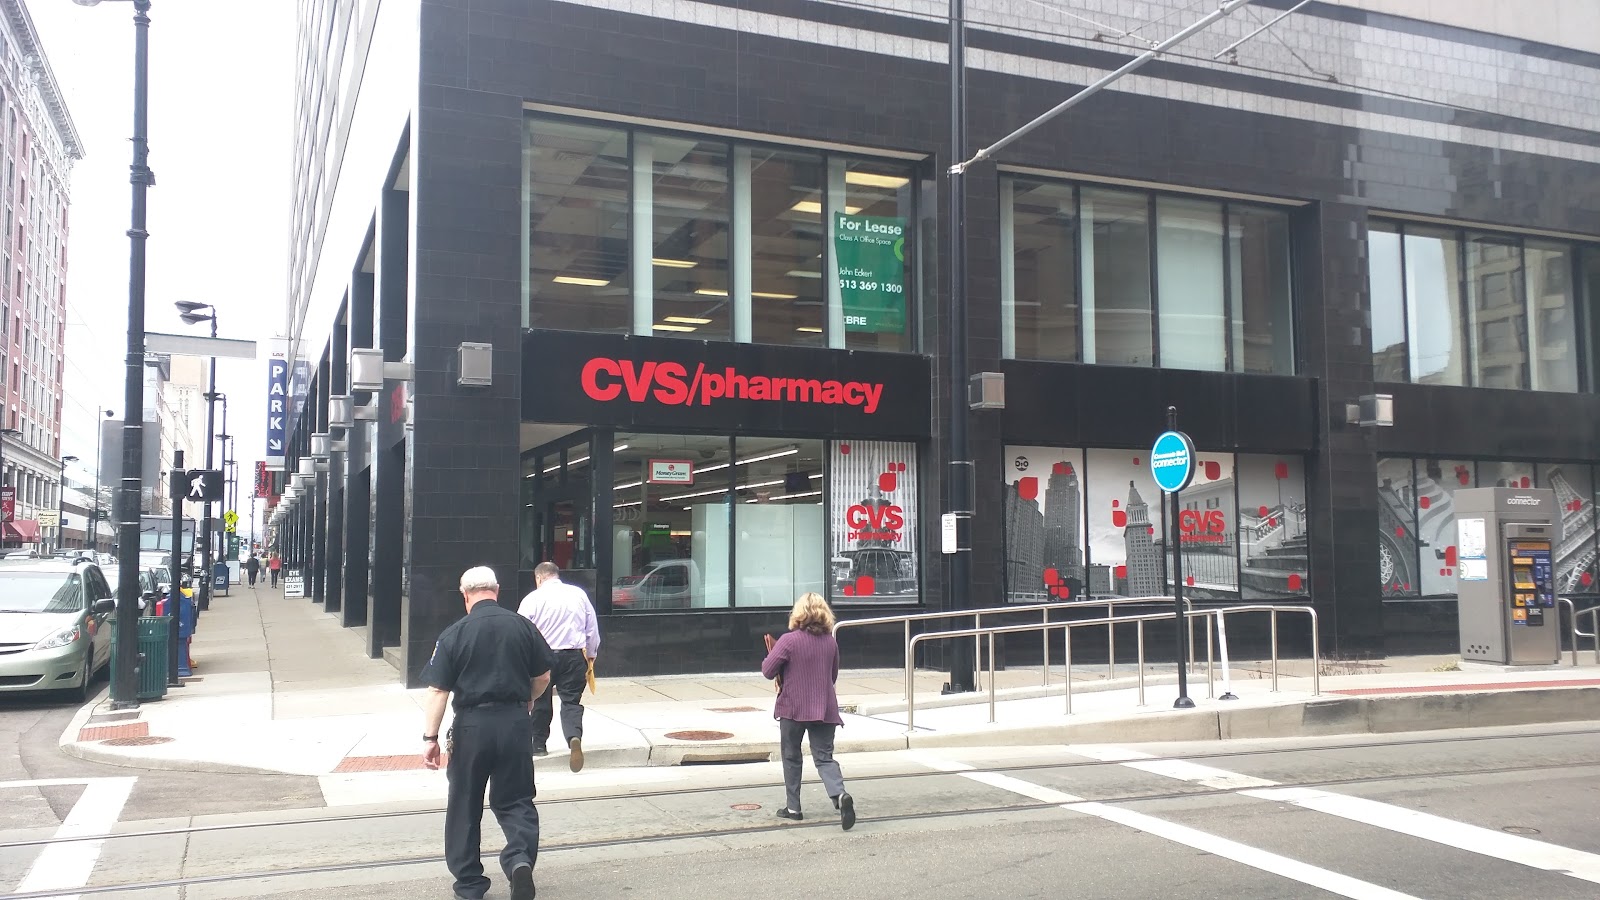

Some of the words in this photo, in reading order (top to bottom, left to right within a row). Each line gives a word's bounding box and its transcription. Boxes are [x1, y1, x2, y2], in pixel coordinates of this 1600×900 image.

[840, 216, 861, 230] For
[865, 220, 902, 235] Lease
[839, 234, 853, 242] Class
[839, 267, 853, 276] John
[839, 279, 857, 289] 513
[859, 281, 877, 291] 369
[881, 283, 902, 294] 1300
[581, 357, 884, 414] CVS/pharmacy
[270, 365, 284, 430] PARK
[1153, 457, 1188, 469] connector
[1507, 497, 1541, 506] connector
[846, 504, 904, 530] CVS
[1179, 509, 1225, 533] CVS
